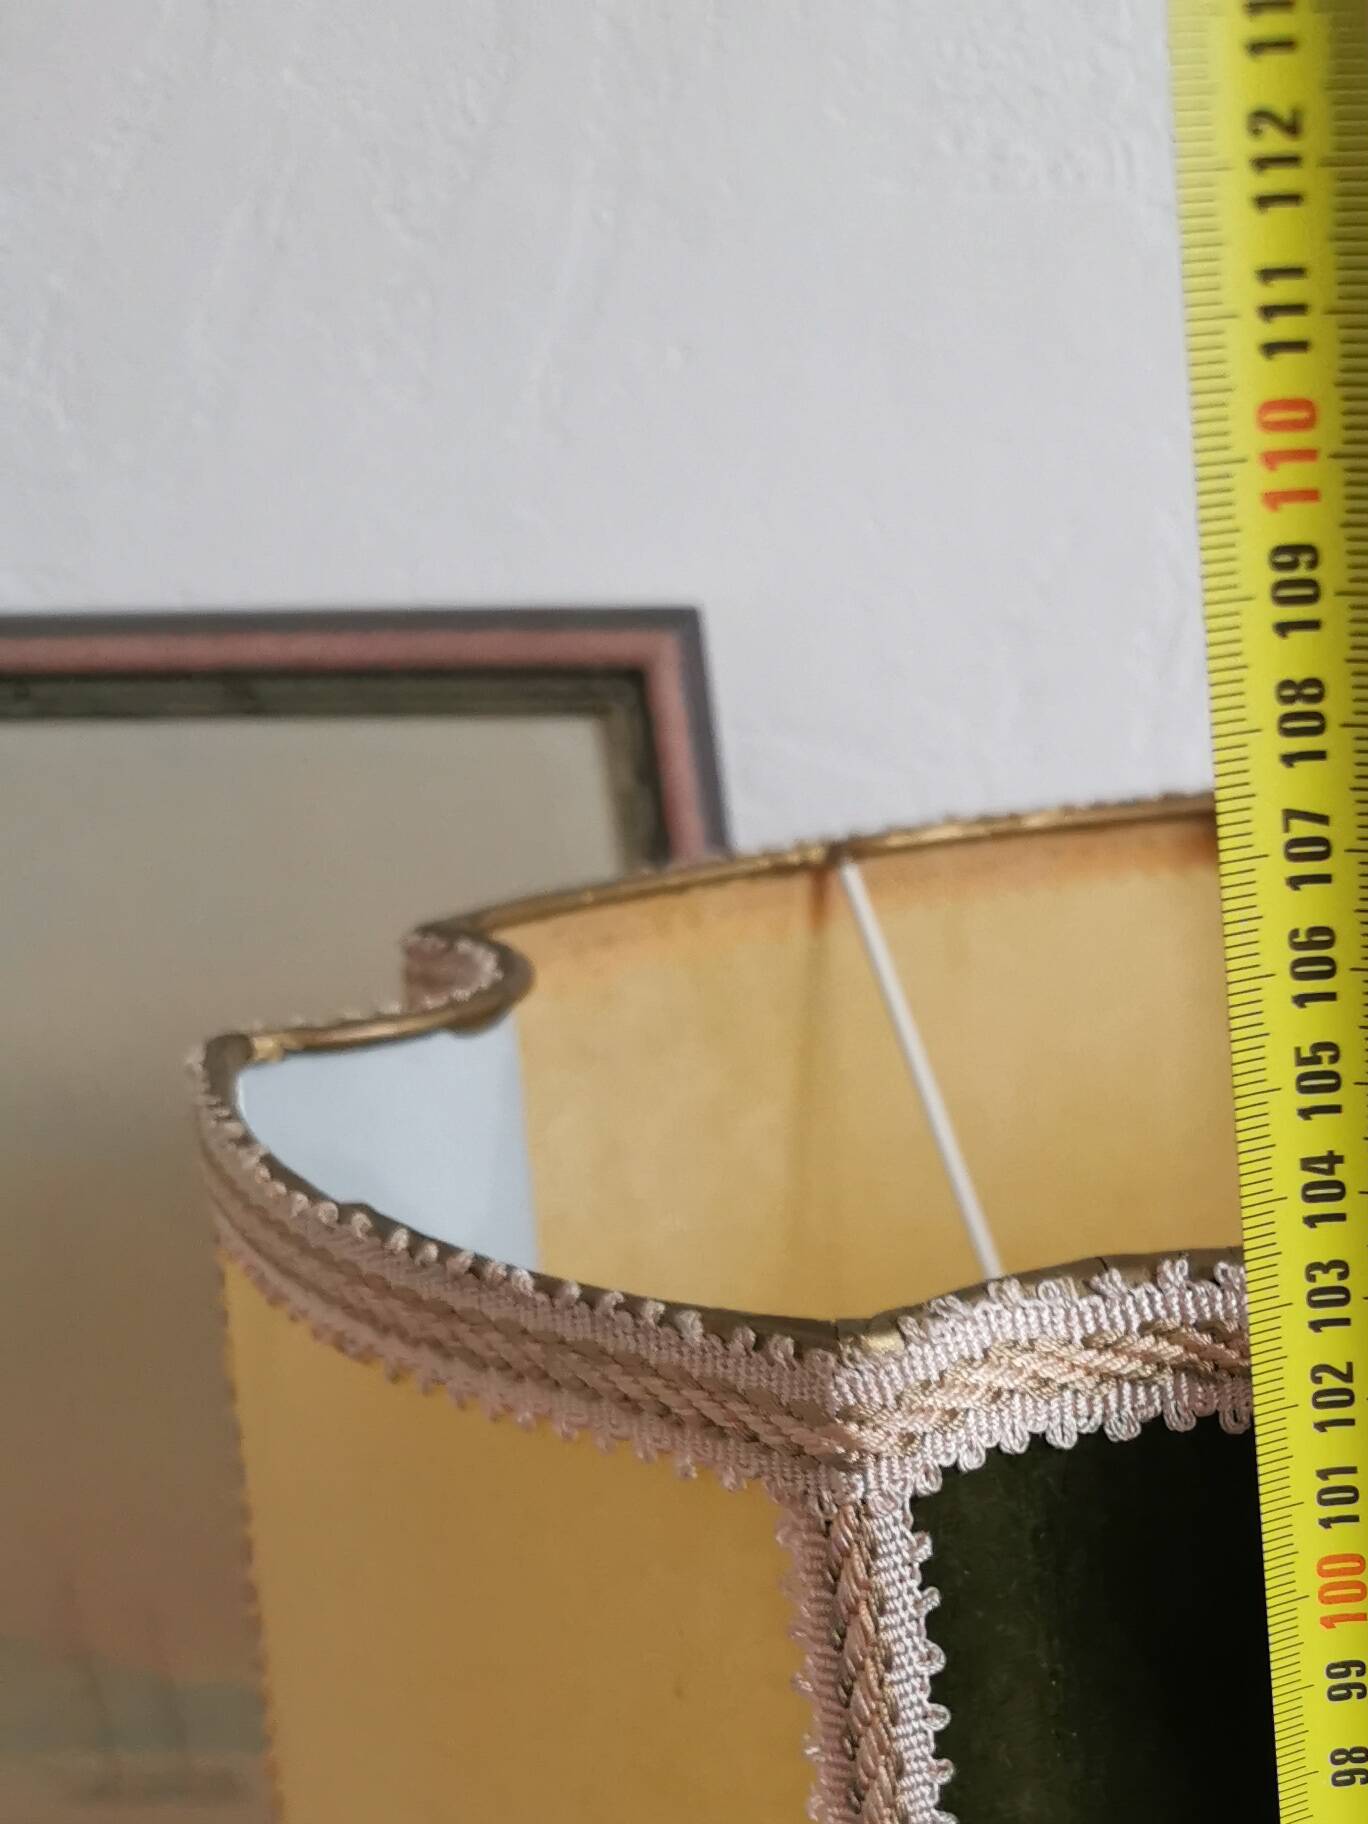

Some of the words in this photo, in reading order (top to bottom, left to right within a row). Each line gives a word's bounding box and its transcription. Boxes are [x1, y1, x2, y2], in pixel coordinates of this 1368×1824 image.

[1242, 0, 1299, 58] 11
[1247, 107, 1304, 213] 112
[1255, 265, 1312, 360] 111
[1256, 396, 1321, 512] 110
[1268, 543, 1322, 639] 109
[1275, 677, 1328, 768] 108
[1282, 808, 1333, 891] 107
[1288, 926, 1338, 1009] 106
[1294, 1041, 1342, 1121] 105
[1300, 1150, 1347, 1229] 104
[1305, 1259, 1351, 1333] 103
[1310, 1361, 1356, 1433] 102
[1316, 1466, 1360, 1529] 101
[1316, 1553, 1368, 1629] 100
[1325, 1660, 1367, 1702] 99
